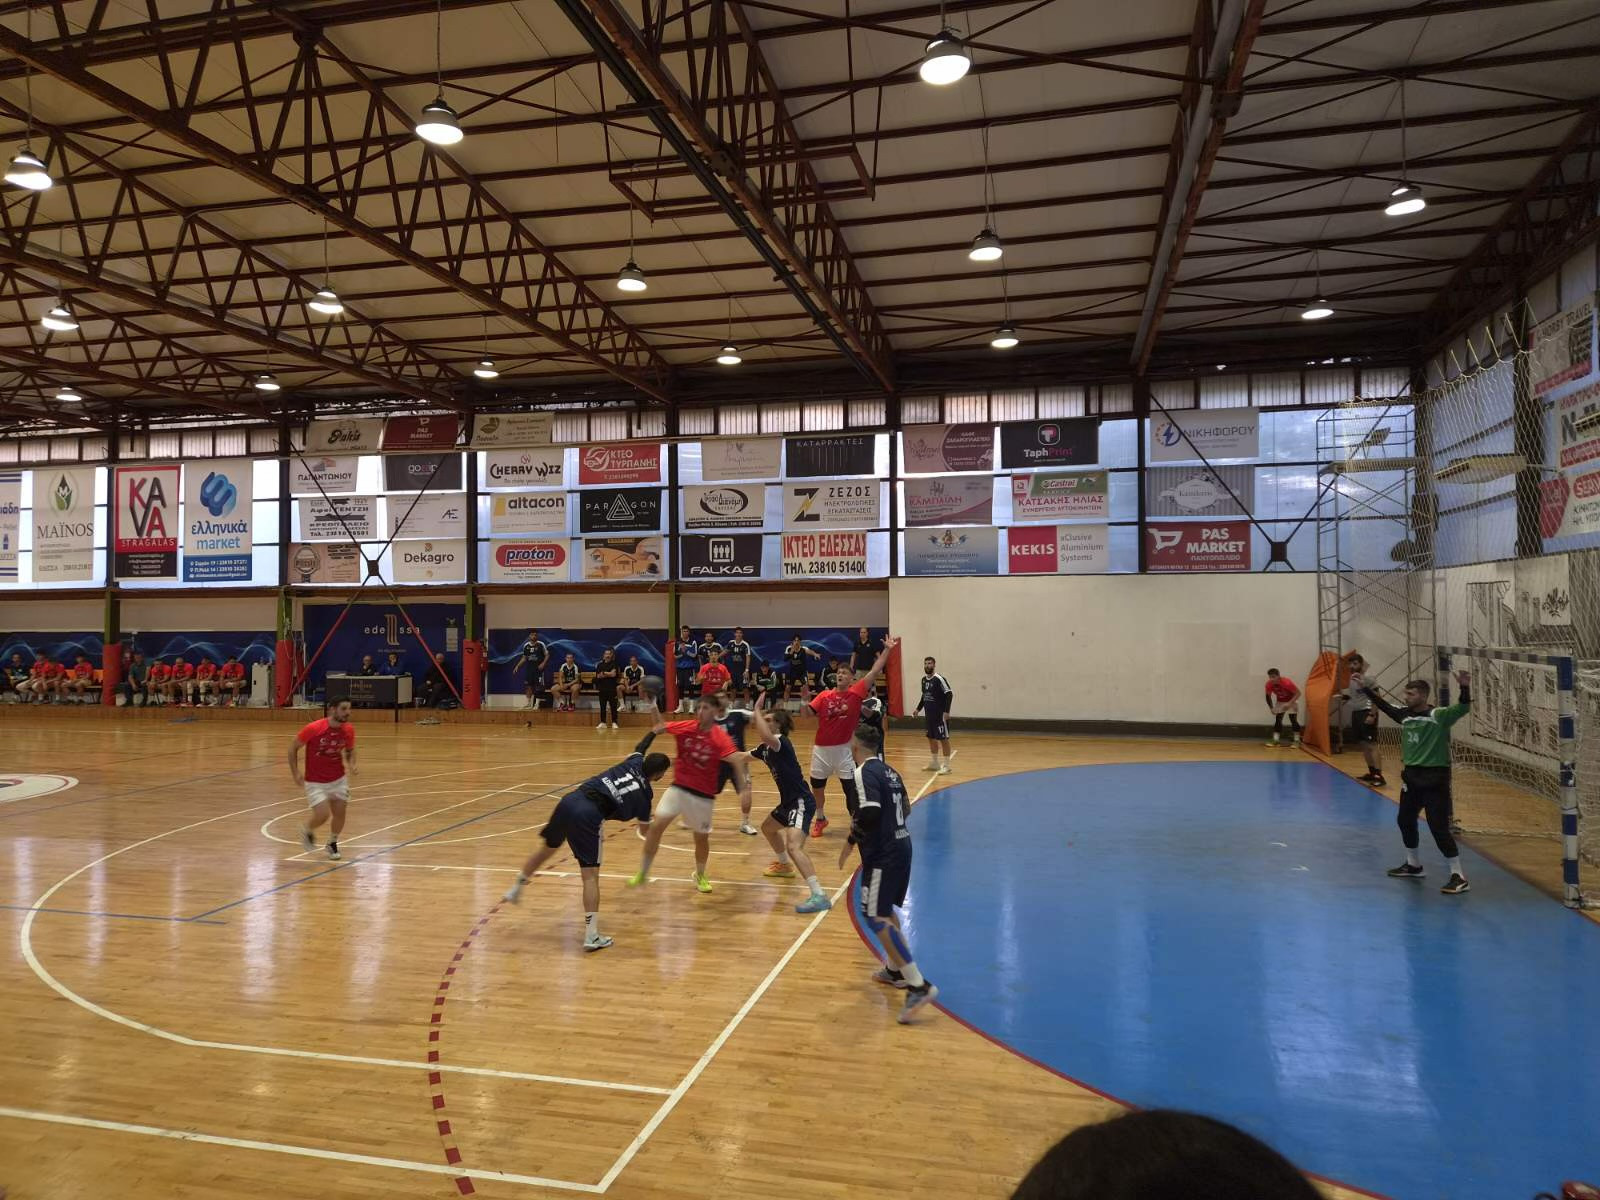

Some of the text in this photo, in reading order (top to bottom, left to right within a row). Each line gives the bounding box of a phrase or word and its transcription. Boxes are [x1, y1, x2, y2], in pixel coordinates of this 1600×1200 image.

[1184, 426, 1255, 438] ΝΙΚΗΦΟΡΟΥ
[610, 450, 634, 459] ΚΤΕΟ
[610, 459, 657, 468] ΤΥΡΠΑΝΗΣ
[1050, 480, 1076, 488] Castrol
[829, 486, 871, 498] ΖΕΖΟΣ
[508, 496, 565, 510] altacon
[1018, 496, 1104, 506] ΚΑΤΣΑΚΗΣ ΗΛΙΑΣ
[191, 519, 247, 536] ελληνικά
[1202, 527, 1229, 540] PAS
[121, 538, 175, 547] STRAGALAS
[197, 536, 241, 551] market
[1060, 543, 1104, 552] Aluminium
[1186, 541, 1246, 553] MARKET
[1011, 543, 1055, 555] KEKIS
[404, 552, 455, 564] Dekagro
[504, 547, 555, 565] proton
[1061, 552, 1094, 562] Systems
[690, 565, 754, 575] FALKAS
[809, 560, 836, 573] 23810
[1407, 731, 1420, 744] 24
[613, 772, 641, 796] 11
